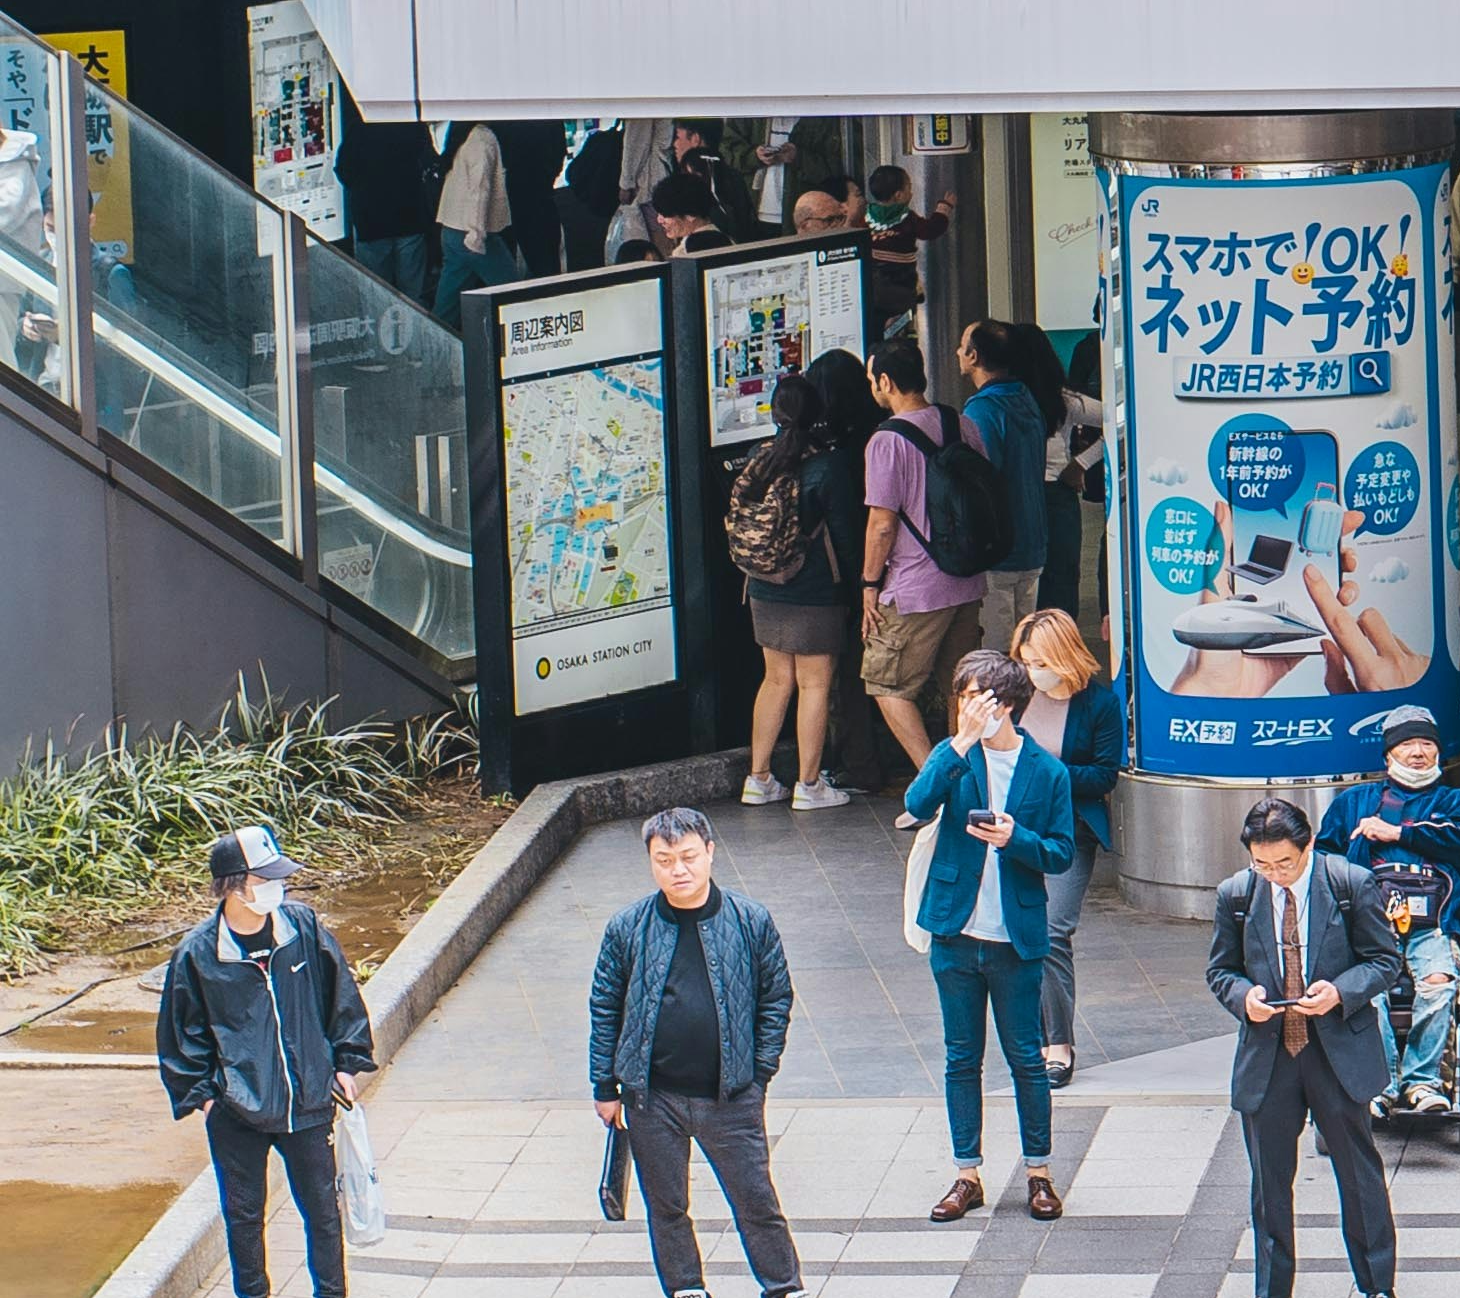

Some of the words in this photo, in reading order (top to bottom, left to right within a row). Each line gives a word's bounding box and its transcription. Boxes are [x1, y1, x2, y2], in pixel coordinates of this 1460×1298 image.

[1141, 199, 1160, 214] JR
[1140, 270, 1416, 355] ネット予約
[511, 345, 529, 356] Area
[530, 336, 573, 352] Information
[1181, 359, 1343, 394] JR西日本予約
[1228, 431, 1284, 442] EXサービスなら
[1228, 446, 1283, 462] 新幹線の
[1373, 451, 1396, 469] 急な
[1219, 464, 1293, 481] 1年前予約が
[1355, 469, 1412, 490] 予定変更や
[1238, 483, 1269, 499] OK!
[1352, 487, 1415, 508] 払いもどしも
[1164, 508, 1198, 525] 窓口に
[1373, 507, 1399, 525] OK!
[1164, 528, 1198, 545] 並ばず
[1151, 546, 1219, 566] 列車の予約が
[1168, 568, 1195, 585] OK!
[556, 654, 589, 671] OSAKA
[592, 644, 630, 664] STATION
[633, 638, 653, 655] CITY
[1251, 718, 1335, 739] スマートEX
